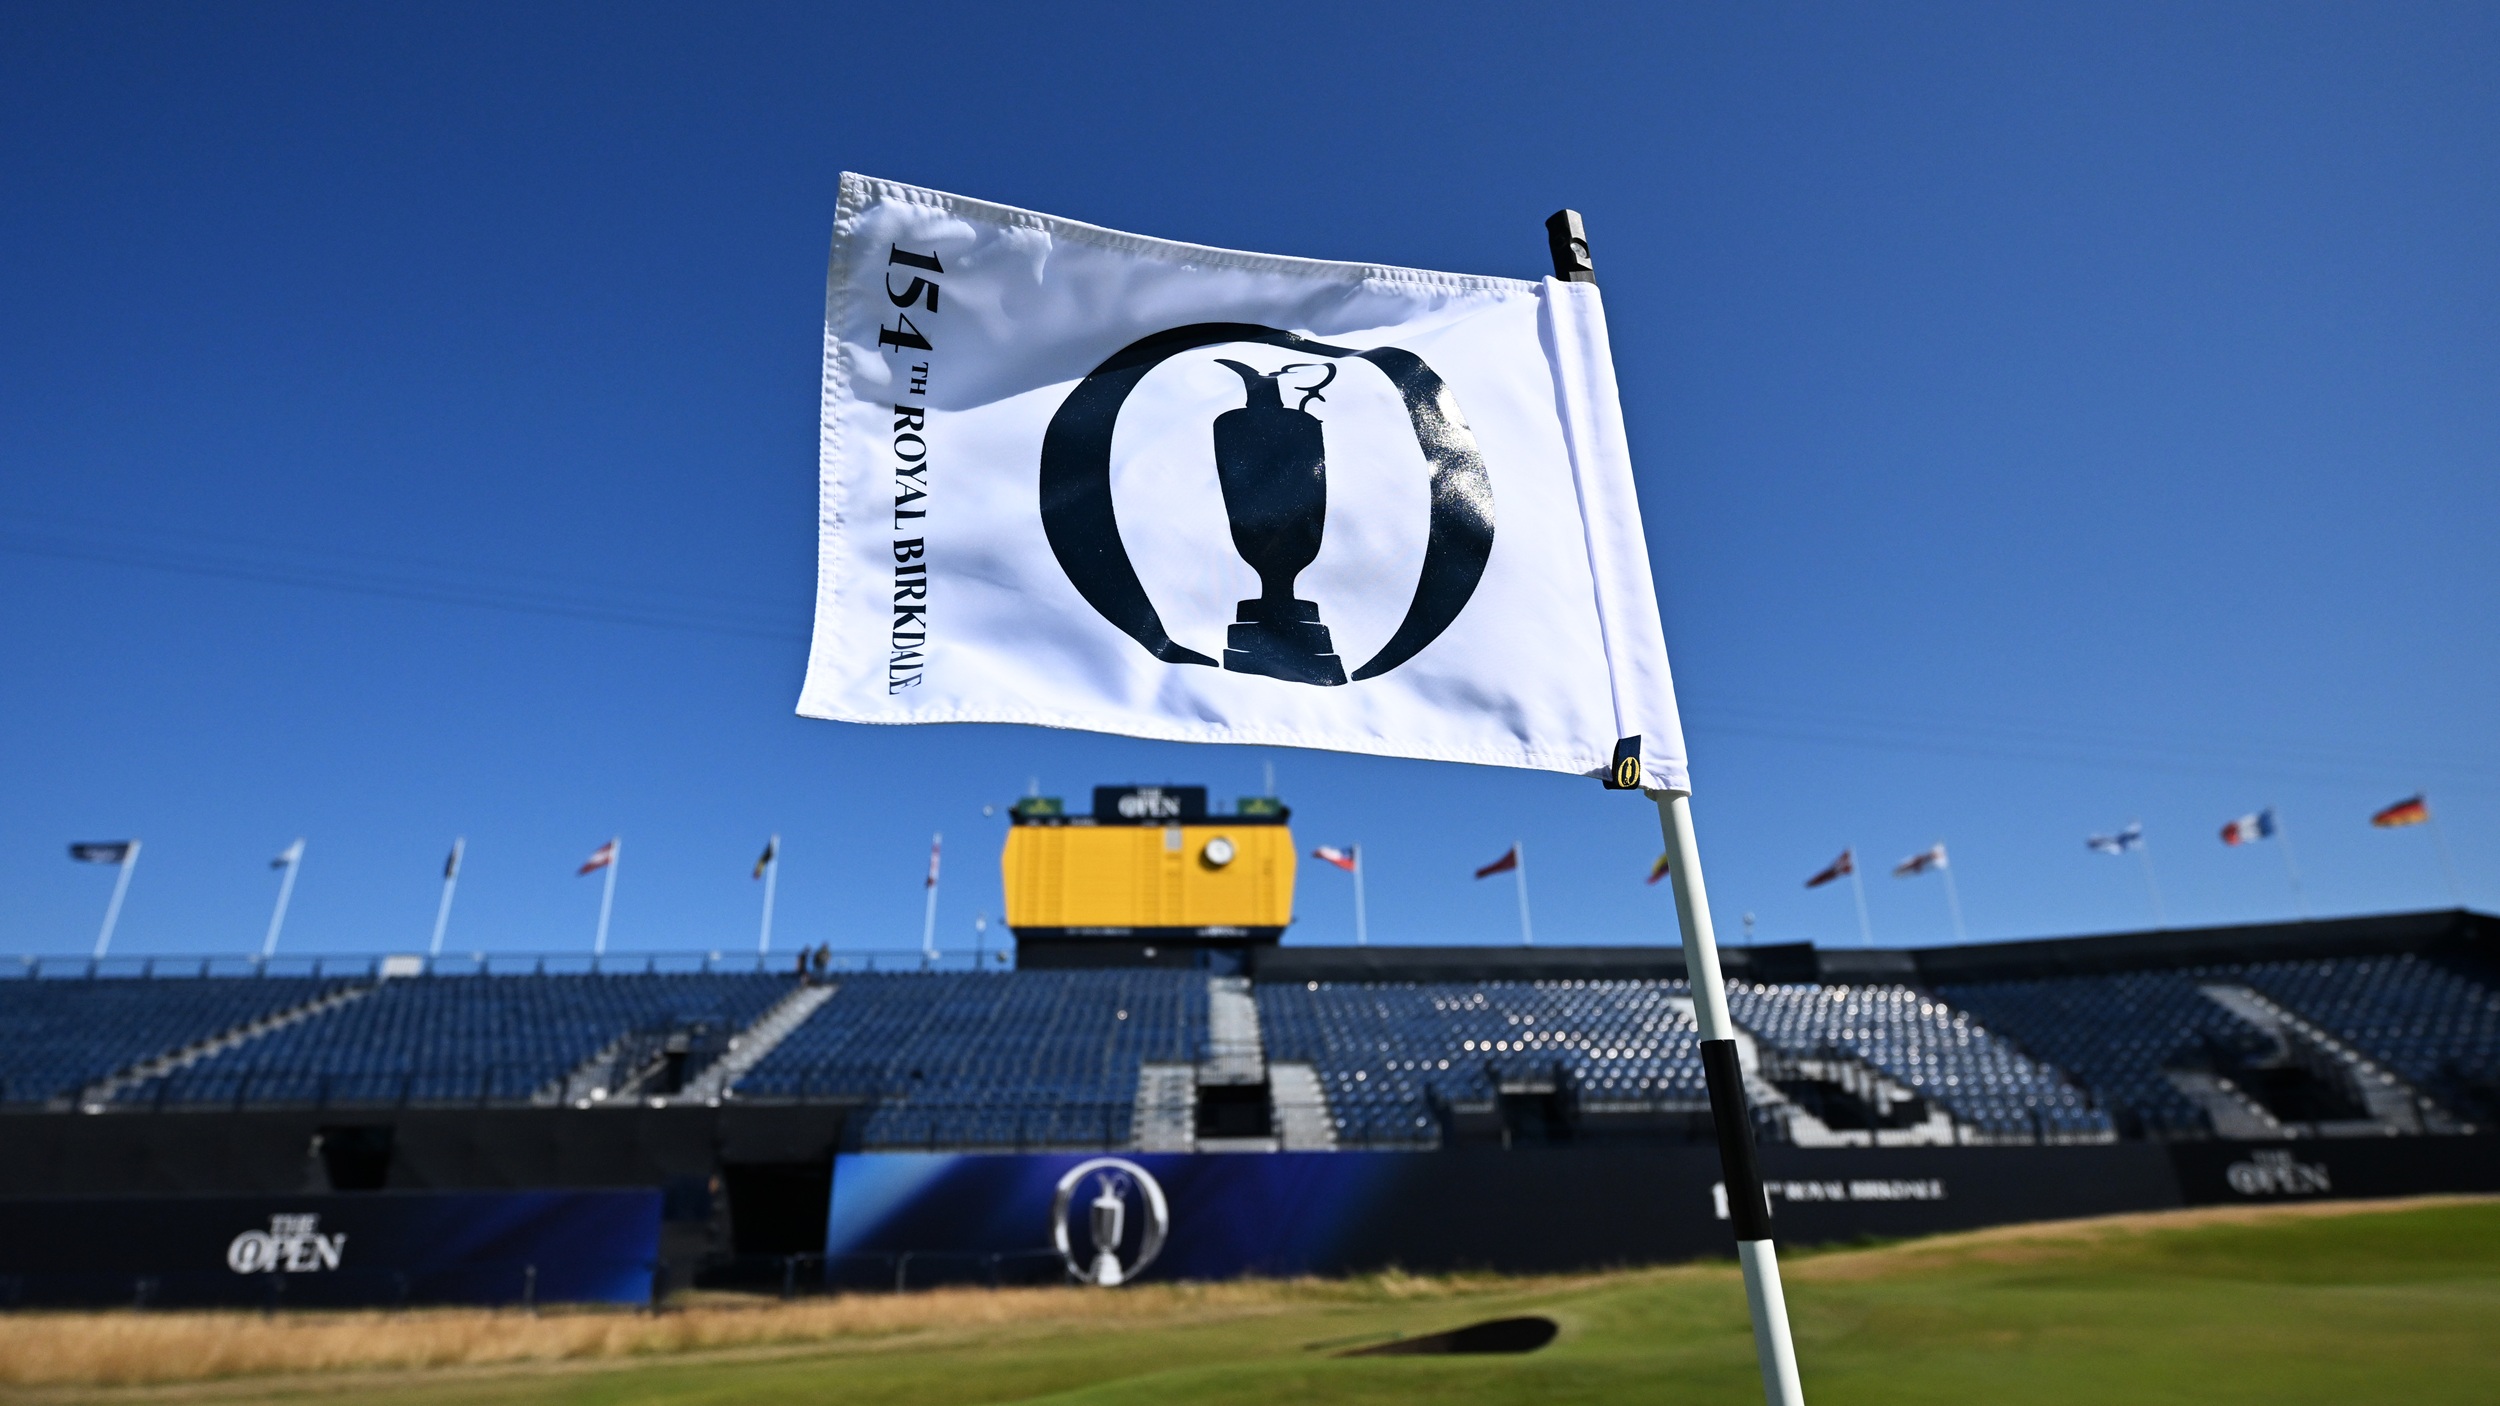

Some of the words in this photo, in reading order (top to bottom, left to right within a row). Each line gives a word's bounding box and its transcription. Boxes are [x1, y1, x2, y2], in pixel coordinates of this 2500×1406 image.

[893, 403, 928, 531] ROYAL
[888, 537, 927, 695] BIRKDALE
[2226, 1161, 2332, 1195] OPEN
[271, 1213, 319, 1234] THE
[227, 1229, 347, 1275] OPEN
